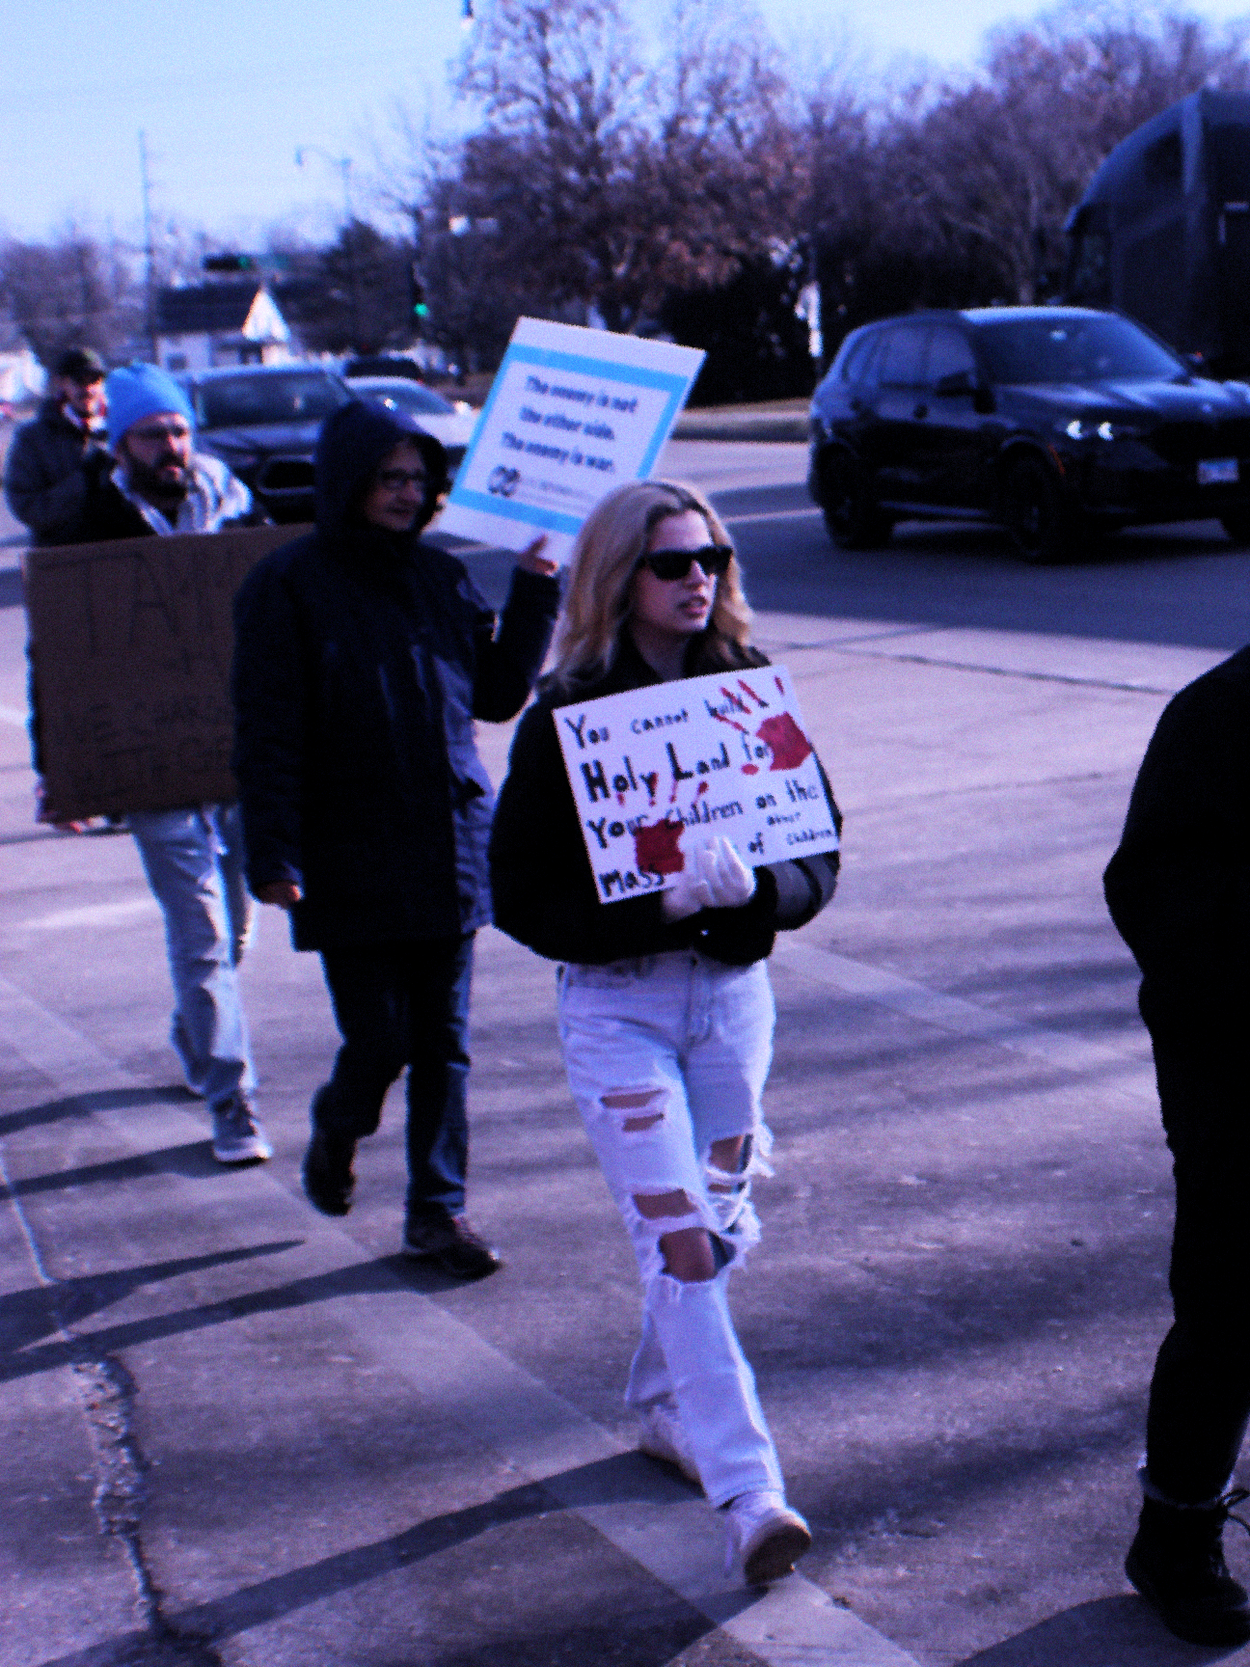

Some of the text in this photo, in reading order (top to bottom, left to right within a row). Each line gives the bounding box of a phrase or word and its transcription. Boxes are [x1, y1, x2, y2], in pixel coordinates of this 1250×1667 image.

[526, 375, 638, 414] The enemy is not
[543, 413, 583, 432] other
[501, 431, 525, 450] The
[525, 442, 569, 466] enemy
[564, 713, 610, 749] You
[630, 708, 689, 735] cannot
[579, 755, 657, 802] Holy
[665, 741, 731, 781] Land
[585, 814, 649, 850] Your
[756, 793, 778, 809] on
[784, 779, 820, 803] the
